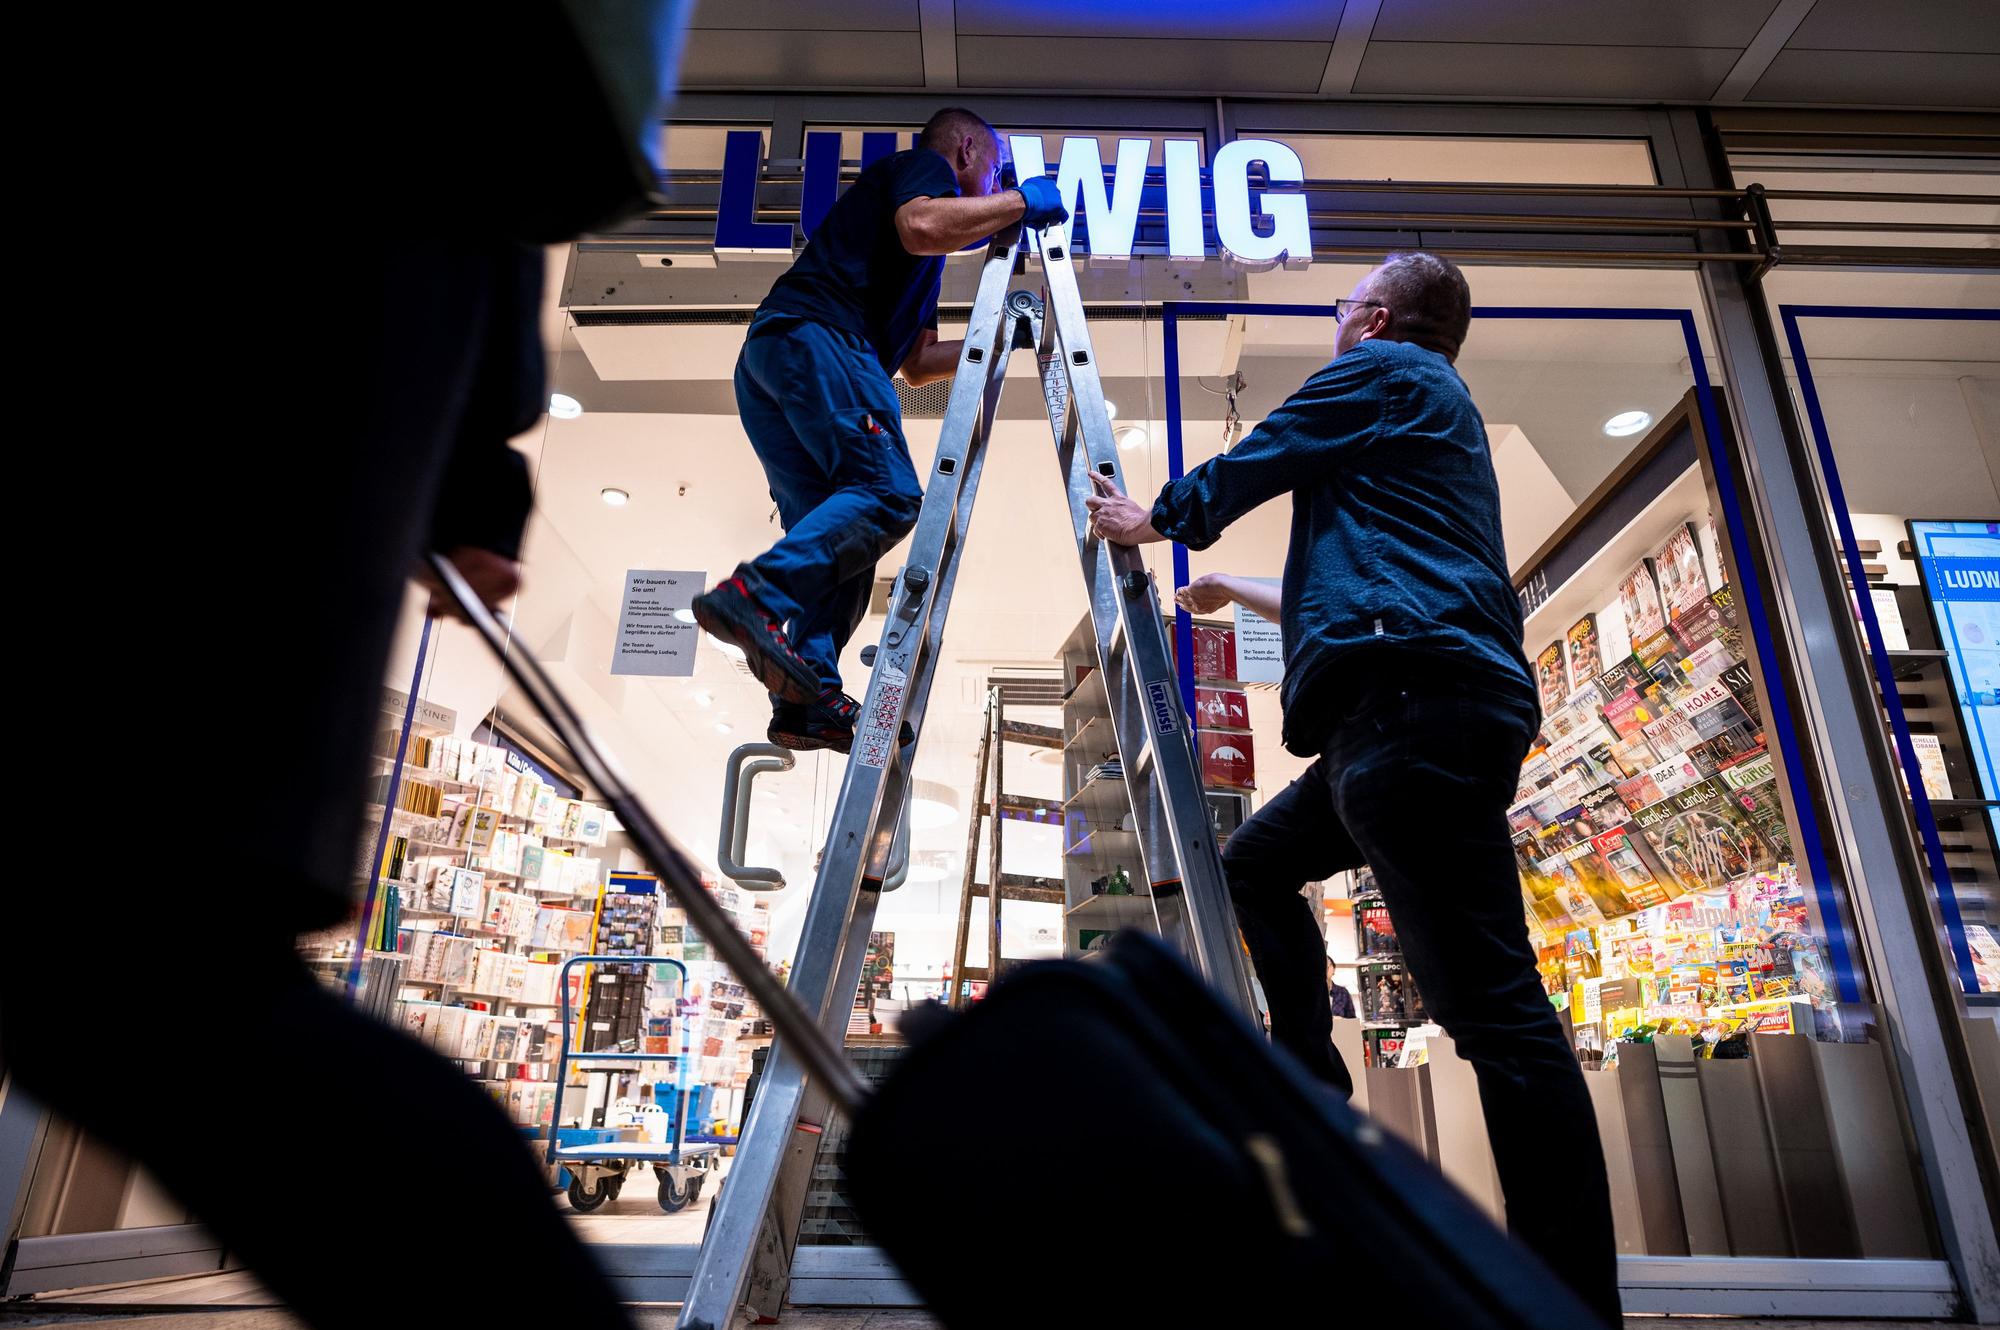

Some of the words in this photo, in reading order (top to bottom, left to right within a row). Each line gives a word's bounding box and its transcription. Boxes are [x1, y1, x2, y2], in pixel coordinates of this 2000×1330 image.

[1149, 684, 1173, 732] KRAUSE
[1684, 687, 1726, 713] H.O.M.E.
[1653, 764, 1678, 784] IDEAT
